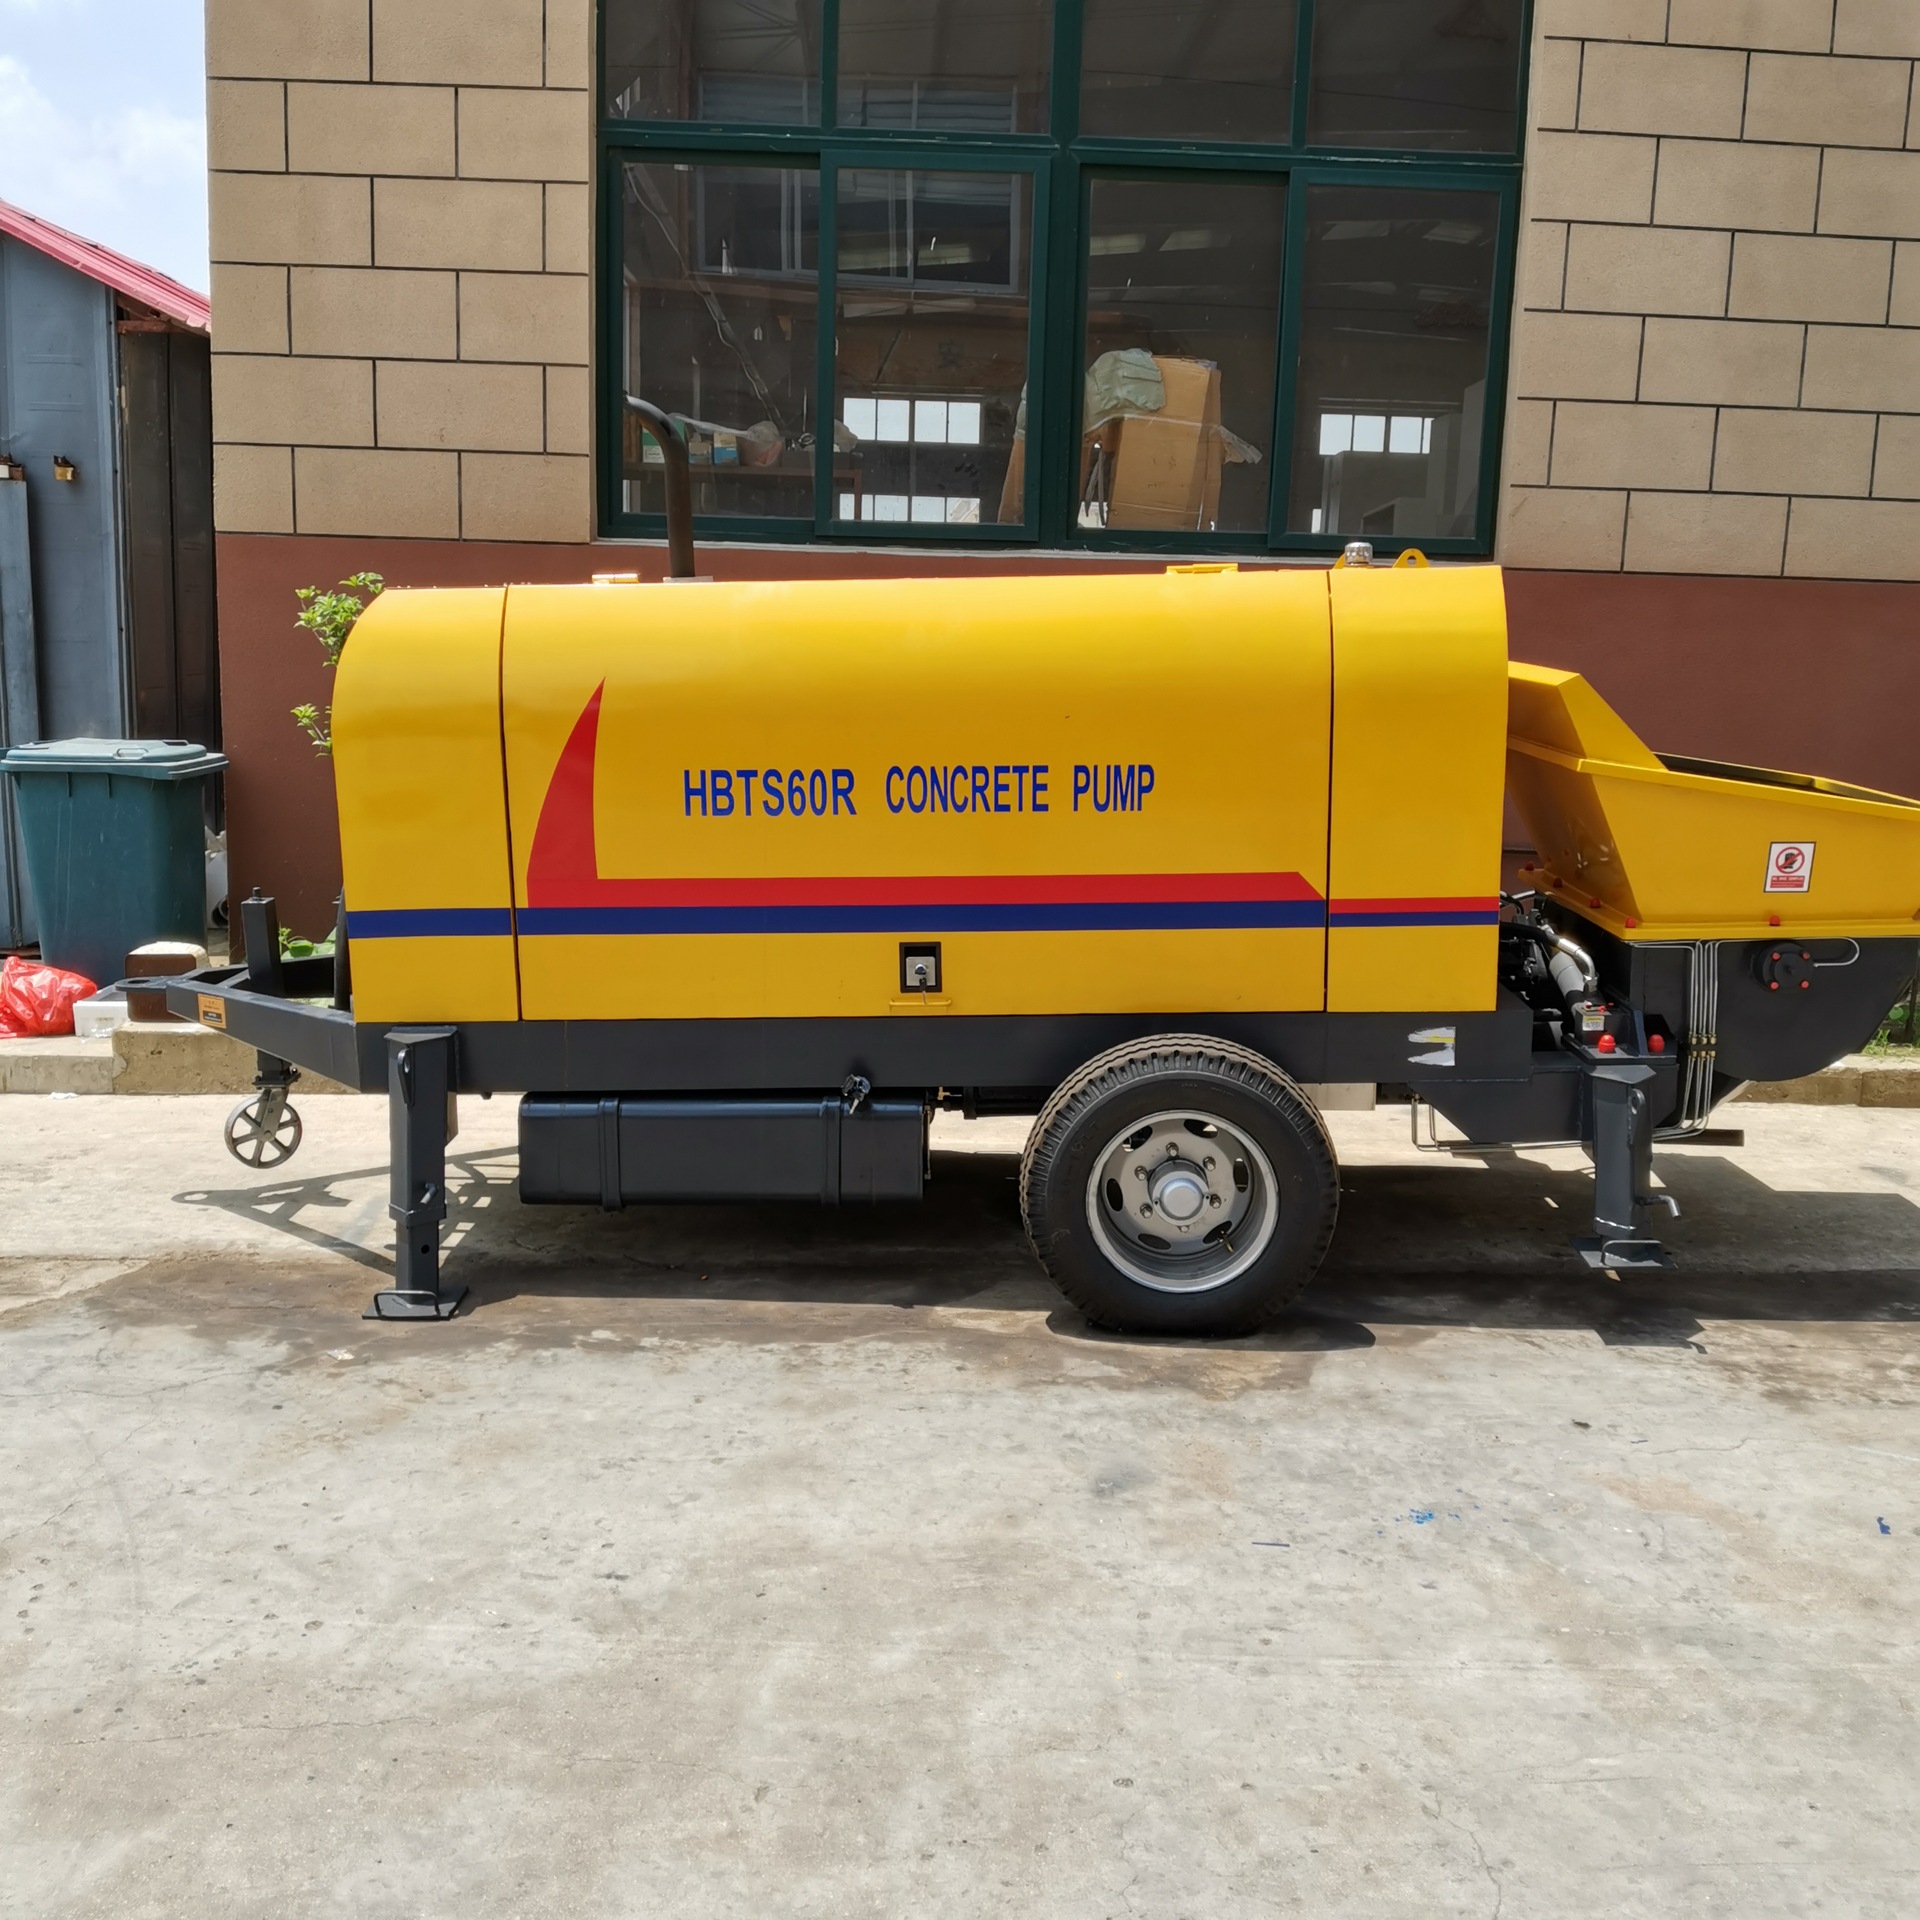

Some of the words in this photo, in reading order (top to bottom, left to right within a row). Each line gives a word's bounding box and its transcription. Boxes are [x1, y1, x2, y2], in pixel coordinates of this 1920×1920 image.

[684, 768, 857, 817] HBTS60R
[885, 765, 1049, 814] CONCRETE
[1073, 764, 1155, 812] PUMP
